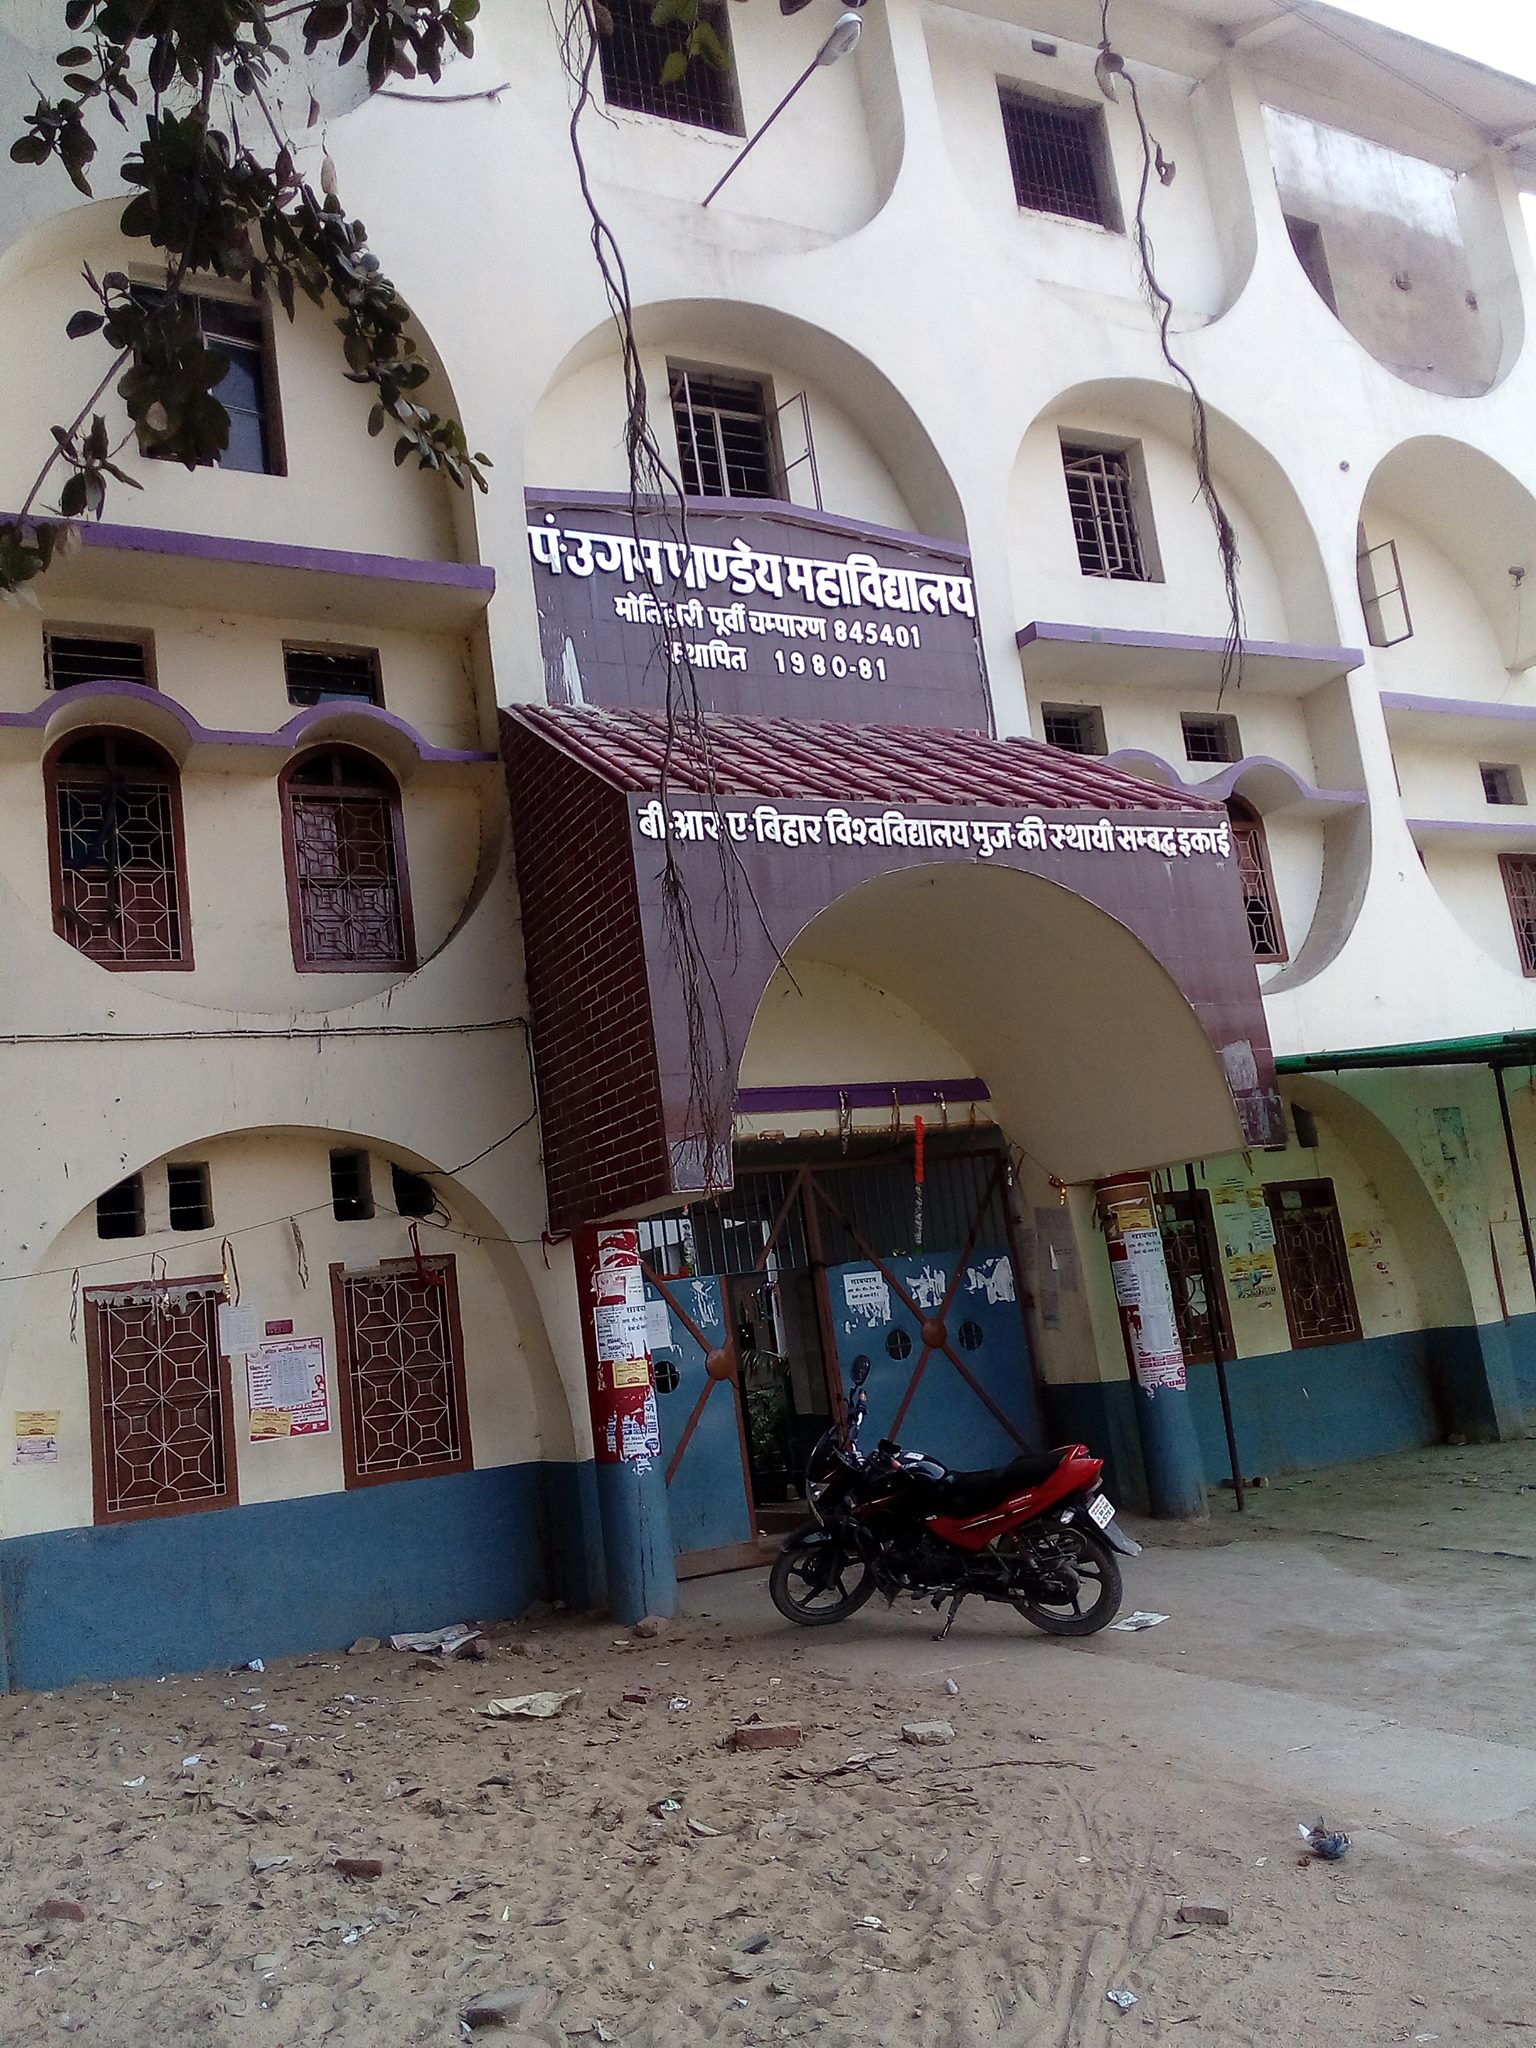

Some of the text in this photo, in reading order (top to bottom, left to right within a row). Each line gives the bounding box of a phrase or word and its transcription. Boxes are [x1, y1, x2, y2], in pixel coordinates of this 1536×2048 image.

[784, 553, 976, 618] महाविद्यालय
[706, 602, 747, 637] पूर्वी
[749, 609, 828, 641] चम्पारण
[833, 619, 921, 649] 845401
[774, 650, 887, 682] 1980-81
[825, 807, 969, 848] विश्वविद्यालय
[1047, 818, 1115, 851] स्थायी
[1115, 825, 1177, 857] सम्बद्ध
[1176, 821, 1231, 858] इकाई
